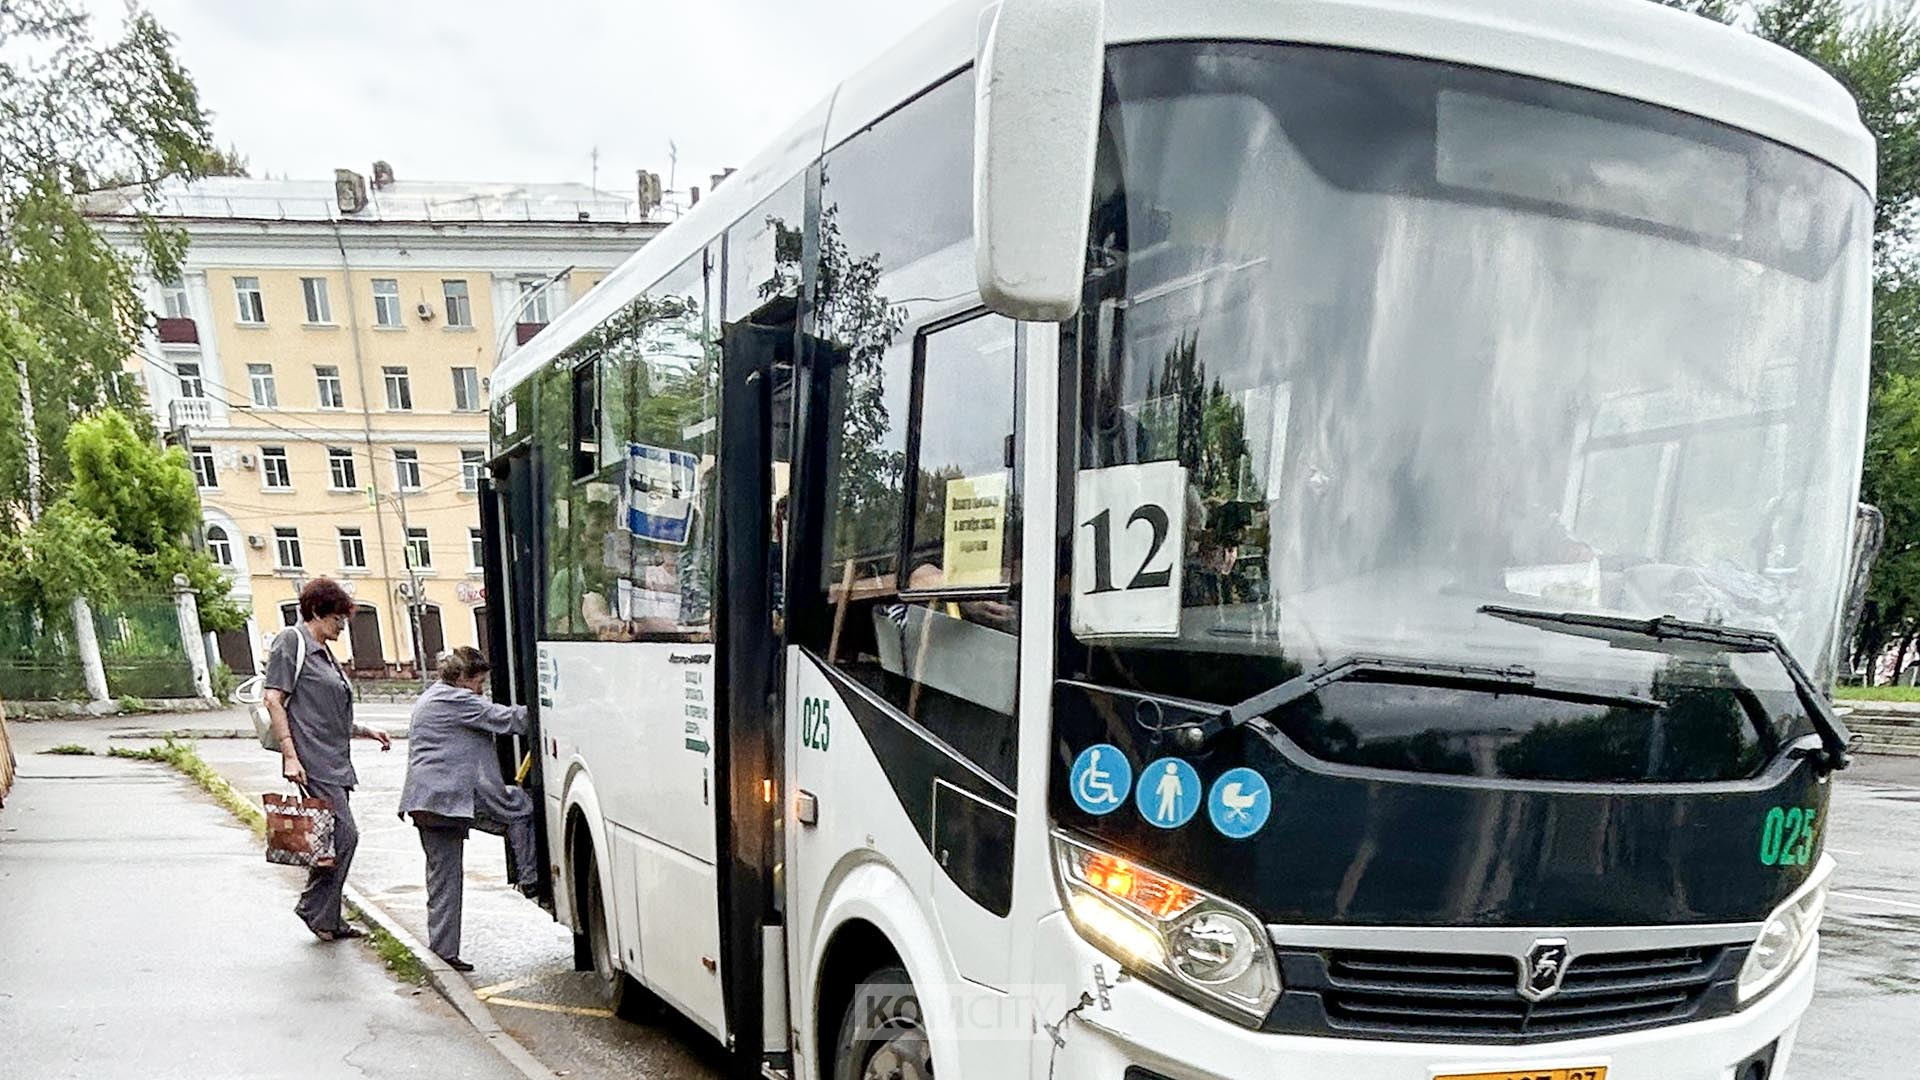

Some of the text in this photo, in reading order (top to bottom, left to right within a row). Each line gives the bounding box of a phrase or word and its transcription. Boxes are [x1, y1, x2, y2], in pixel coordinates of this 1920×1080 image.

[1081, 503, 1173, 595] 12
[803, 696, 830, 751] 025
[1761, 806, 1816, 866] 025
